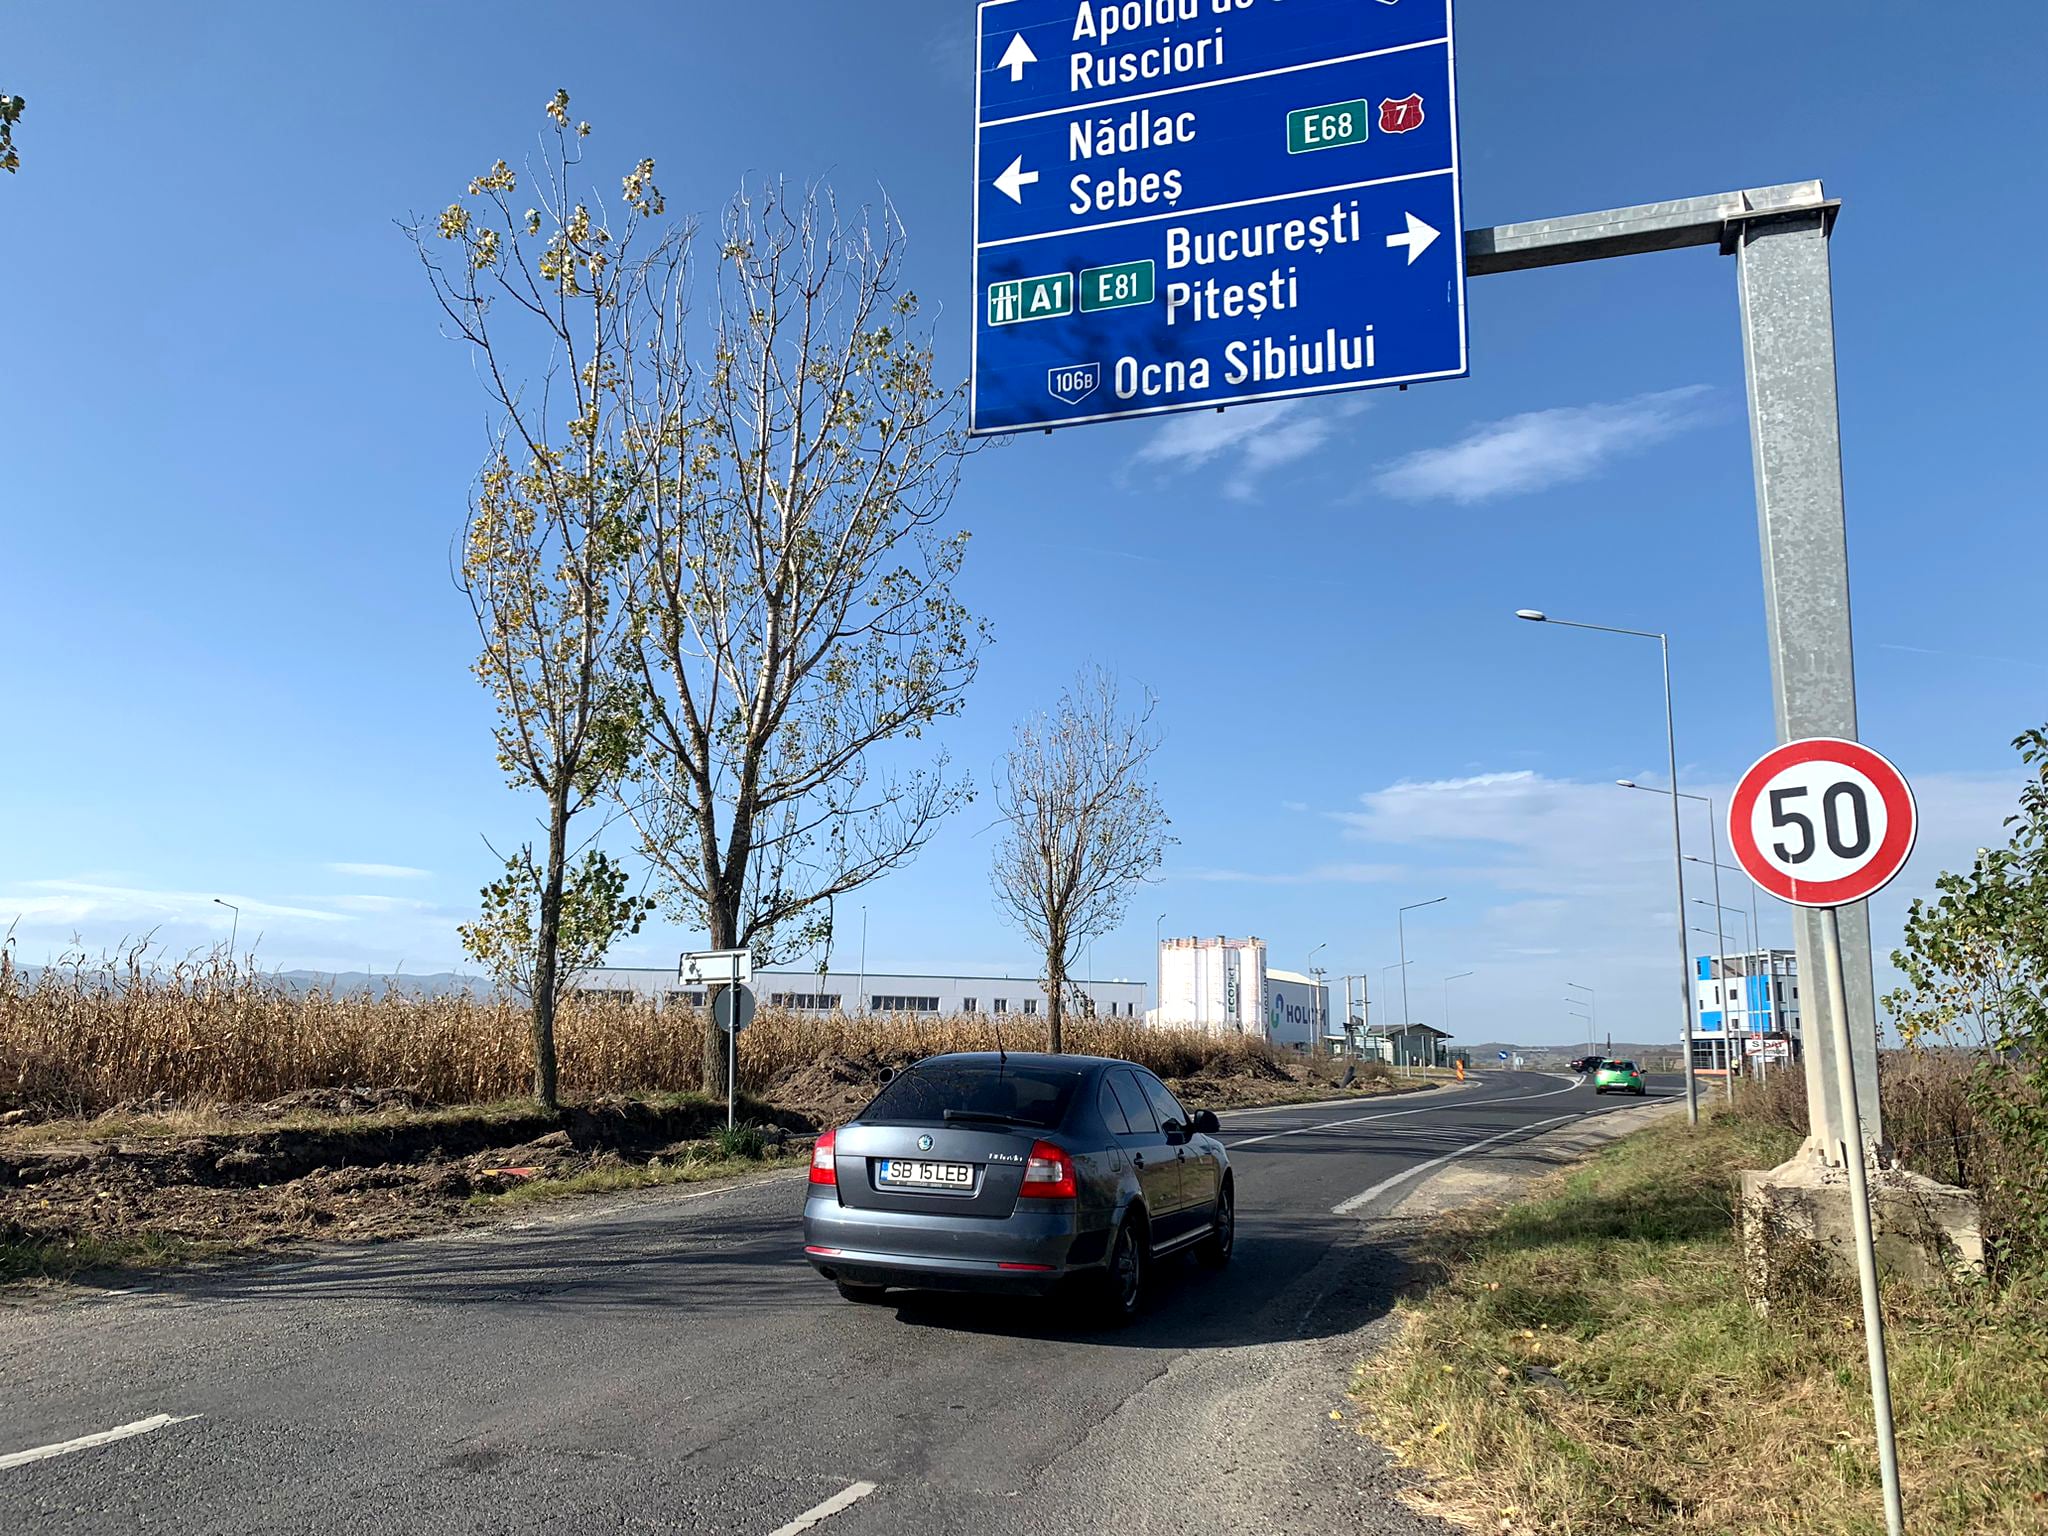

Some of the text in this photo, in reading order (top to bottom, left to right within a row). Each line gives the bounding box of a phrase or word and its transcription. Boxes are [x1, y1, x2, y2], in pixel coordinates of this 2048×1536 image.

[1072, 0, 1198, 46] Apoldu
[1071, 28, 1224, 92] Rusciori
[1069, 112, 1196, 162] Nădlac
[1304, 113, 1354, 144] E68
[1396, 104, 1408, 125] 7
[1070, 168, 1183, 216] Sebeș
[1167, 201, 1361, 270] București
[1030, 281, 1062, 312] A1
[1099, 273, 1137, 302] E81
[1167, 267, 1298, 326] Pitești
[1056, 371, 1093, 393] 106B
[1115, 325, 1376, 400] Ocna Sibiului
[1769, 781, 1871, 864] 50
[891, 1161, 968, 1182] SB 15 LEB
